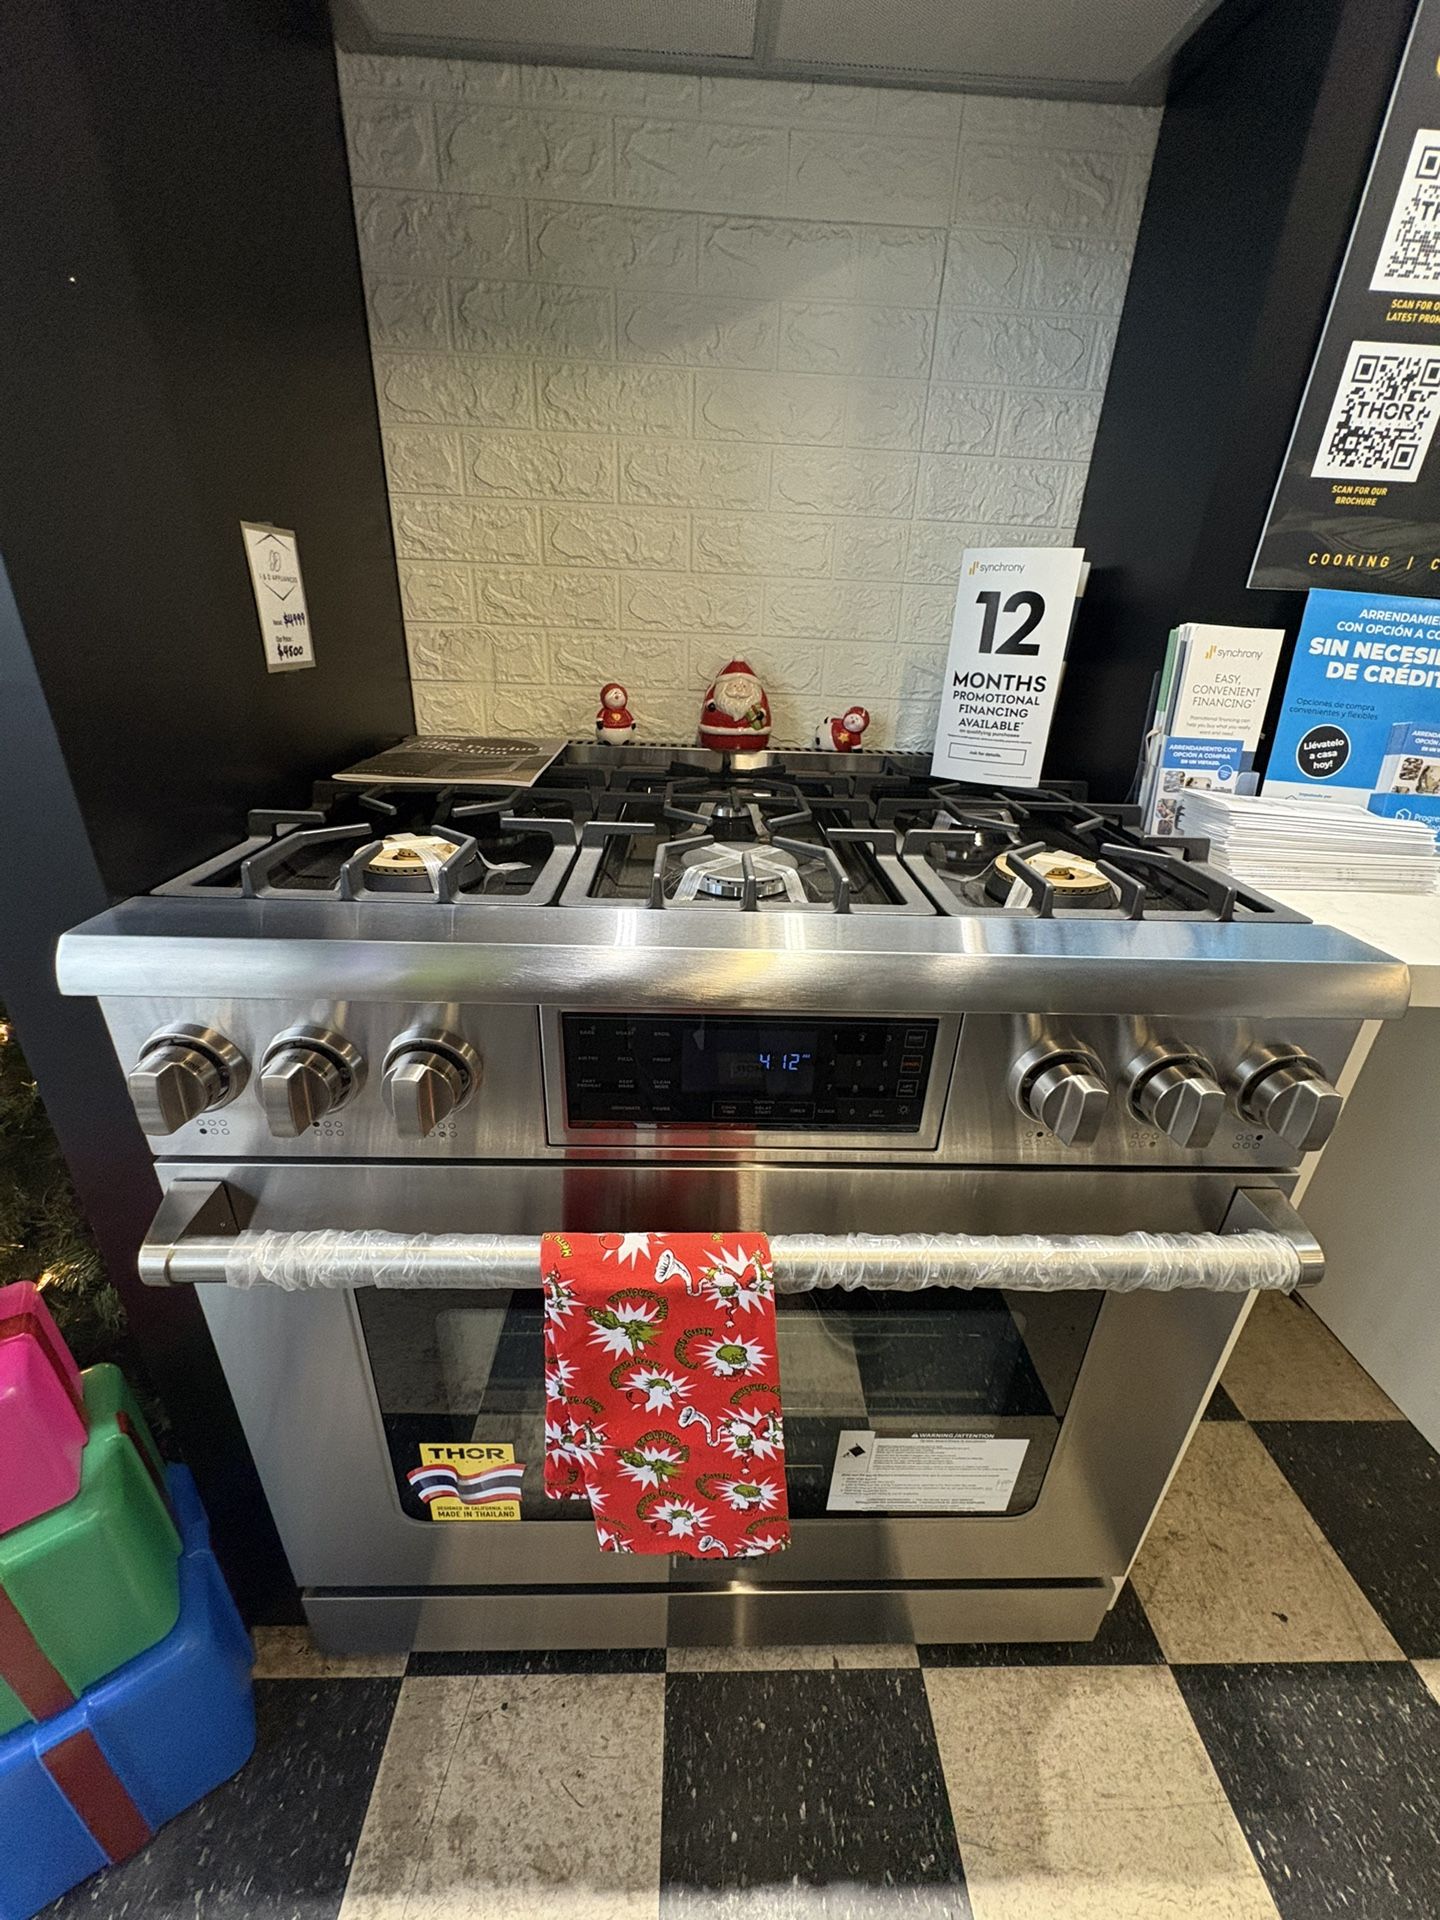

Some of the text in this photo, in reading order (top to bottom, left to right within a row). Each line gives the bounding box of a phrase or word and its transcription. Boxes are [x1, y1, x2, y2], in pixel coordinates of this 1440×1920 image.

[1391, 299, 1414, 310] SCAN
[1415, 300, 1431, 311] FOR
[1386, 312, 1418, 322] LATEST
[1357, 402, 1415, 421] THOR
[1331, 485, 1388, 496] SCAN FOR OUR
[1335, 496, 1377, 507] BROCHURE
[979, 561, 1026, 574] synchrony
[1308, 553, 1390, 569] COOKING
[975, 590, 1046, 656] 12
[1336, 620, 1363, 633] CON
[1365, 624, 1413, 638] OPCIÓN
[1414, 629, 1424, 639] A
[277, 645, 304, 661] $4500
[1217, 647, 1263, 661] synchrony
[1308, 637, 1350, 657] SIN
[1326, 661, 1360, 681] DE
[953, 670, 1047, 692] MONTHS
[1215, 673, 1242, 686] EASY,
[952, 690, 1040, 706] PROMOTIONAL
[1192, 684, 1261, 698] CONVENIENT
[958, 704, 1028, 719] FINANCING
[1296, 697, 1333, 707] Opciones
[1345, 703, 1375, 712] compra
[1289, 706, 1340, 717] convenientes
[1347, 711, 1378, 721] flexibles
[1169, 744, 1223, 753] ARRENDAMIENTO
[1303, 738, 1345, 751] Llévatelo
[1173, 751, 1197, 759] OPCIÓN
[1204, 752, 1231, 760] COMPRA
[1309, 750, 1338, 760] a casa
[1313, 759, 1334, 770] hoy!
[428, 1447, 506, 1460] THOR
